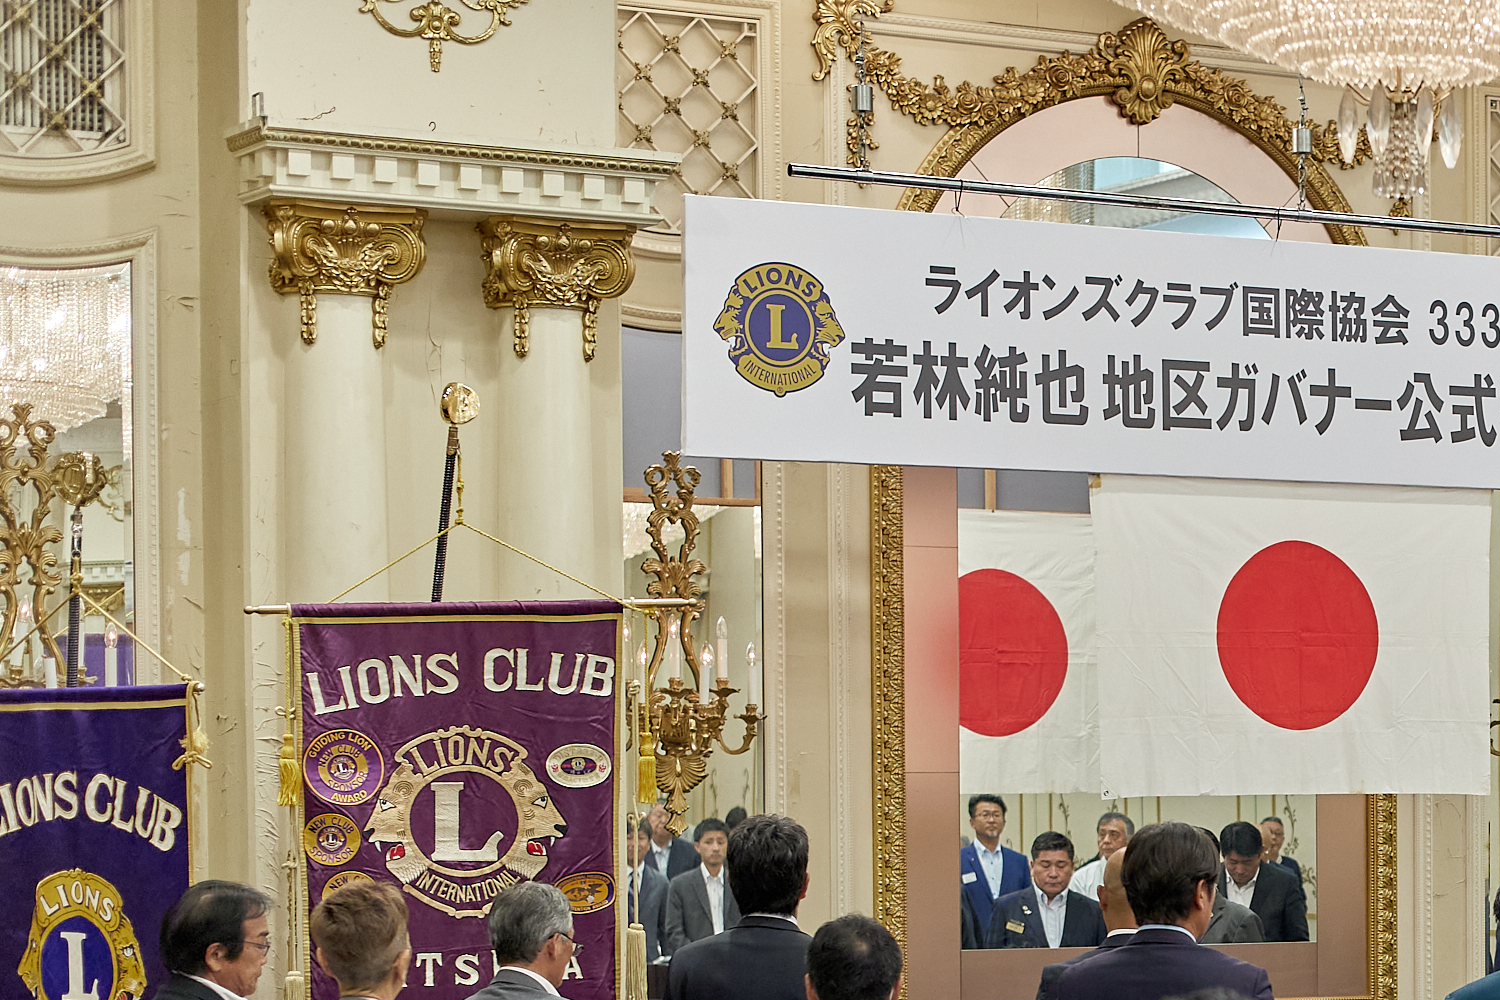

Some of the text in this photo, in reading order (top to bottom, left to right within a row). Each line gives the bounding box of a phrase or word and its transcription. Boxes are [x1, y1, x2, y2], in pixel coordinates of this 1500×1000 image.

[742, 267, 817, 298] LIONS
[925, 265, 1410, 346] ライオンズクラブ国際協会
[766, 303, 799, 350] L
[743, 359, 817, 386] INTERNATIONAL
[305, 648, 615, 715] LIONS CLUB
[308, 732, 372, 758] GUIDING LION
[319, 745, 361, 767] NEW CLUB
[410, 735, 514, 776] LIONS
[328, 771, 368, 792] SPONSOR
[331, 790, 368, 803] AWARD
[0, 771, 182, 851] IONS CLUB
[308, 817, 355, 834] NEW CLUB
[430, 781, 504, 862] L
[309, 846, 354, 863] SPONSOR
[40, 881, 115, 922] LIONS
[415, 869, 521, 904] INTERNATIONAL
